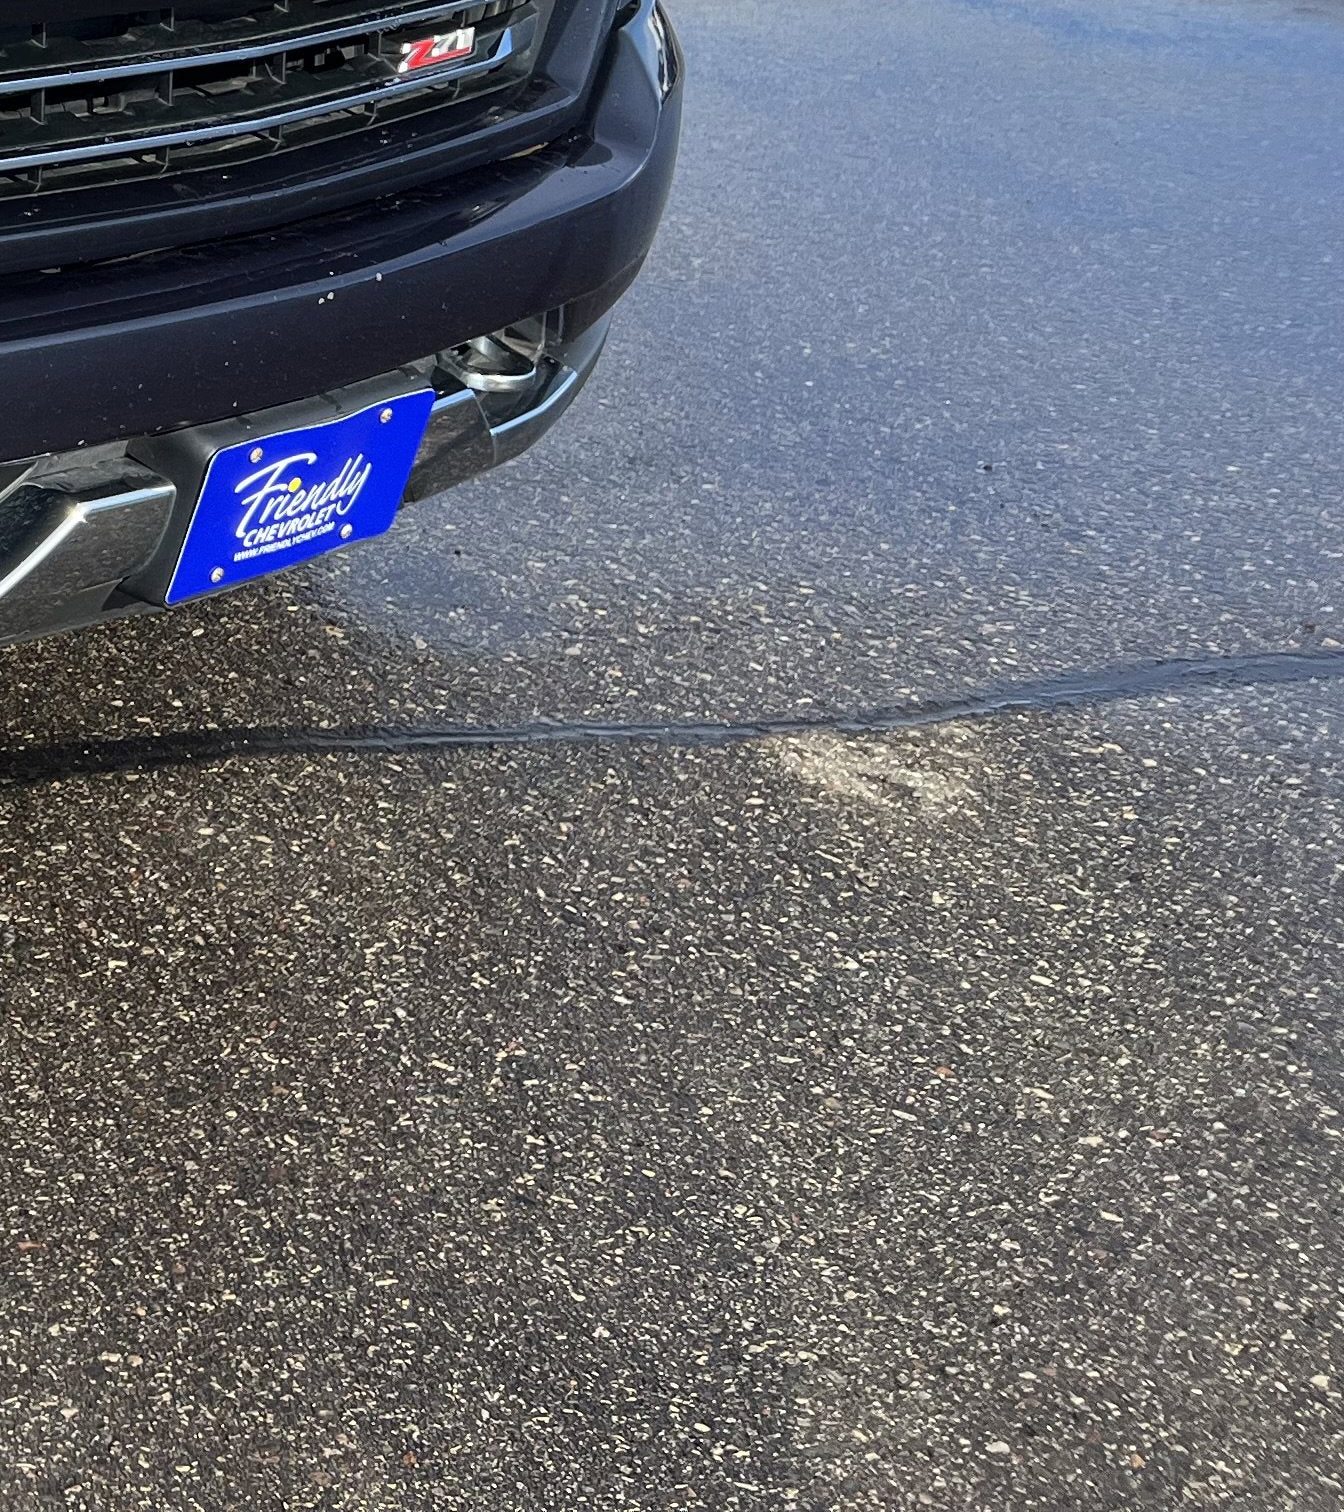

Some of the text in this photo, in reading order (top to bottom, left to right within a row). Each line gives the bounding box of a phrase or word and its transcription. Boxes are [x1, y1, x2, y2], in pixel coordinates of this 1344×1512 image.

[398, 27, 475, 73] Z71
[234, 452, 373, 538] Friendly
[243, 503, 337, 548] CHEVROLET
